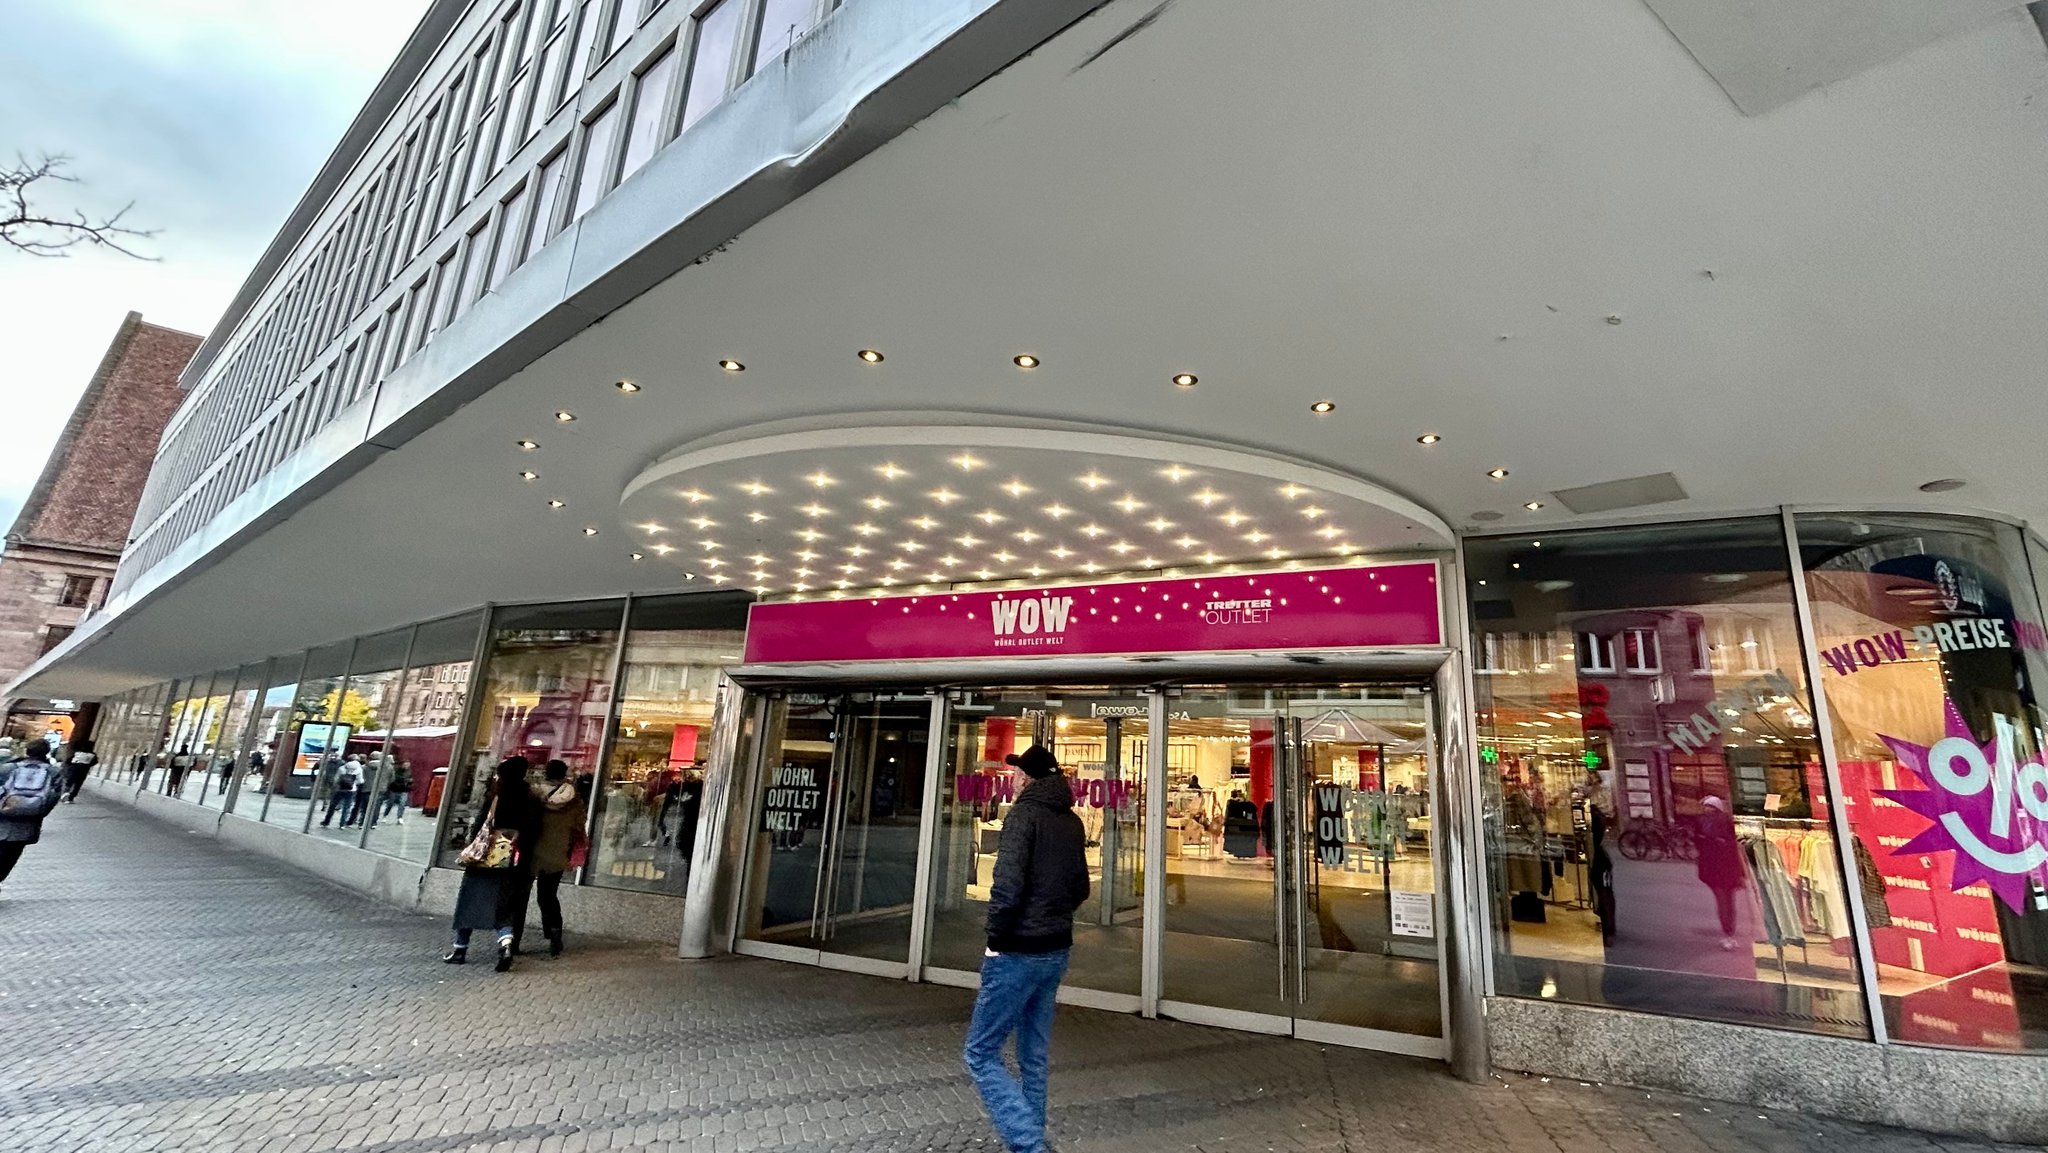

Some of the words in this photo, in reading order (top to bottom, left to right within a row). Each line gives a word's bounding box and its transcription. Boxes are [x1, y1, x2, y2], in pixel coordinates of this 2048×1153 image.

[1205, 599, 1272, 610] TRETTER
[991, 596, 1072, 635] WOW
[1205, 608, 1273, 625] OUTLET
[994, 638, 1016, 647] WÖHRL
[1018, 637, 1044, 646] OUTLET
[1046, 636, 1064, 645] WELT
[1821, 629, 1908, 677] WOW
[1911, 618, 2012, 654] PREISE
[772, 763, 817, 787] WÖHRL
[767, 788, 821, 810] OUTLET
[957, 774, 1014, 805] WOW
[765, 810, 802, 831] WELT
[1883, 875, 1931, 890] WÖHRL
[1890, 916, 1938, 933] WÖHRL
